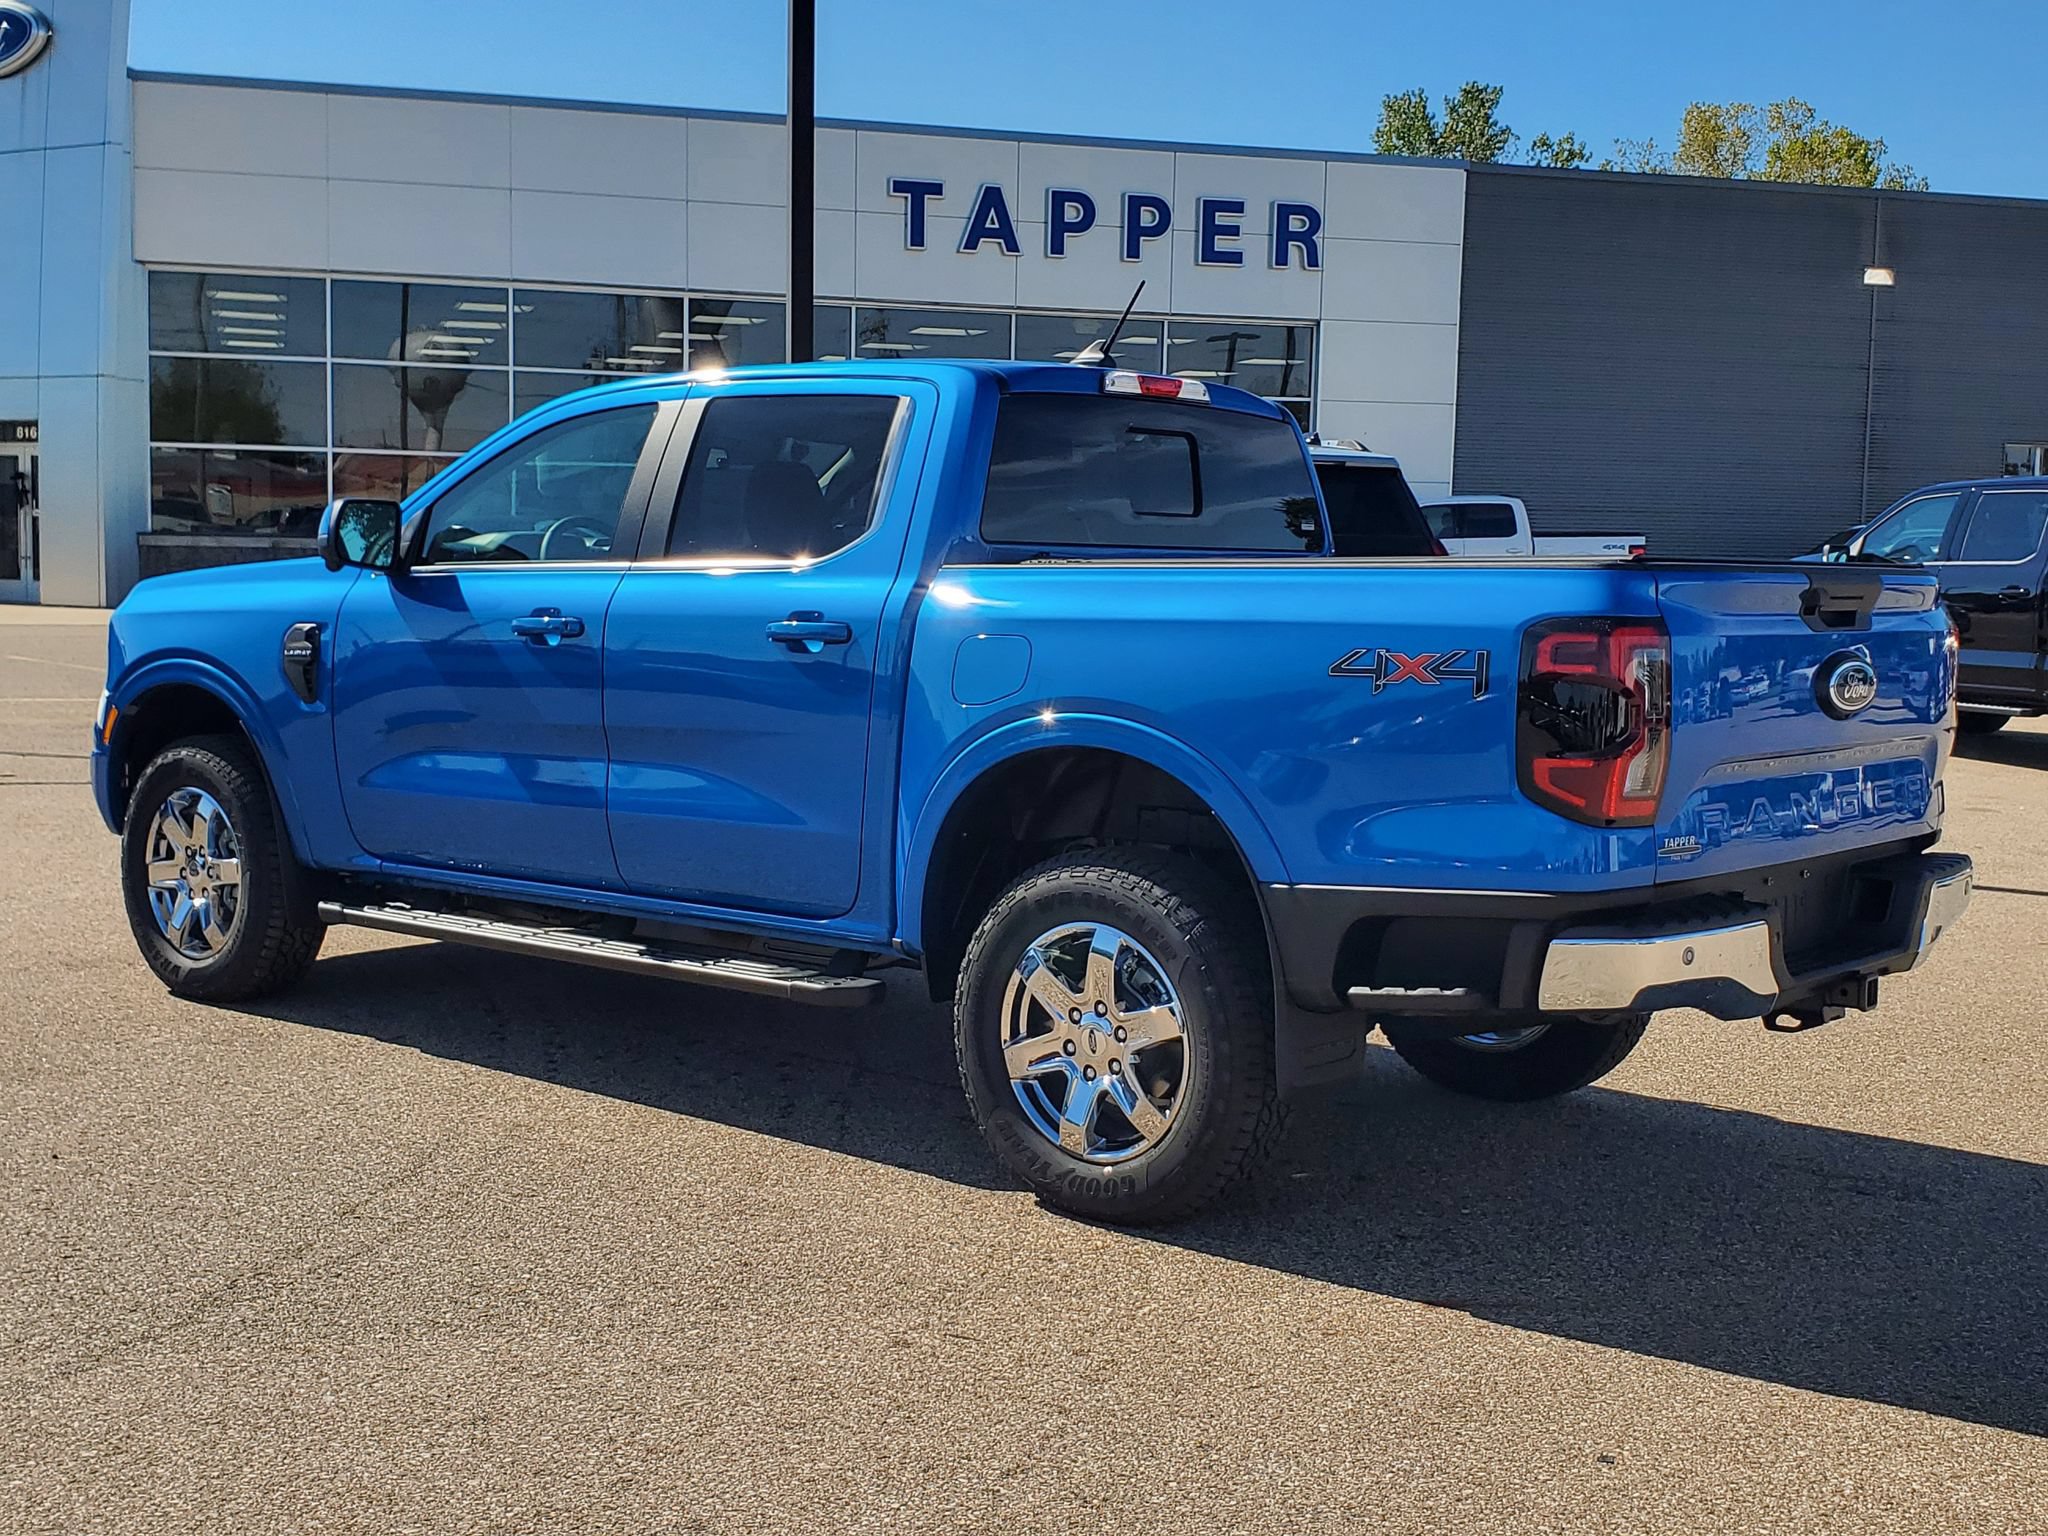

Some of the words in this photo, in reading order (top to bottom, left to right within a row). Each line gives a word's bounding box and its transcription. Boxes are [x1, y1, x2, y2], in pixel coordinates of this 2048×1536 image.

[888, 177, 1324, 270] TAPPER
[16, 426, 37, 439] 816
[1844, 671, 1869, 699] Ford
[1694, 773, 1929, 843] RANGER
[1664, 835, 1696, 848] TAPPER
